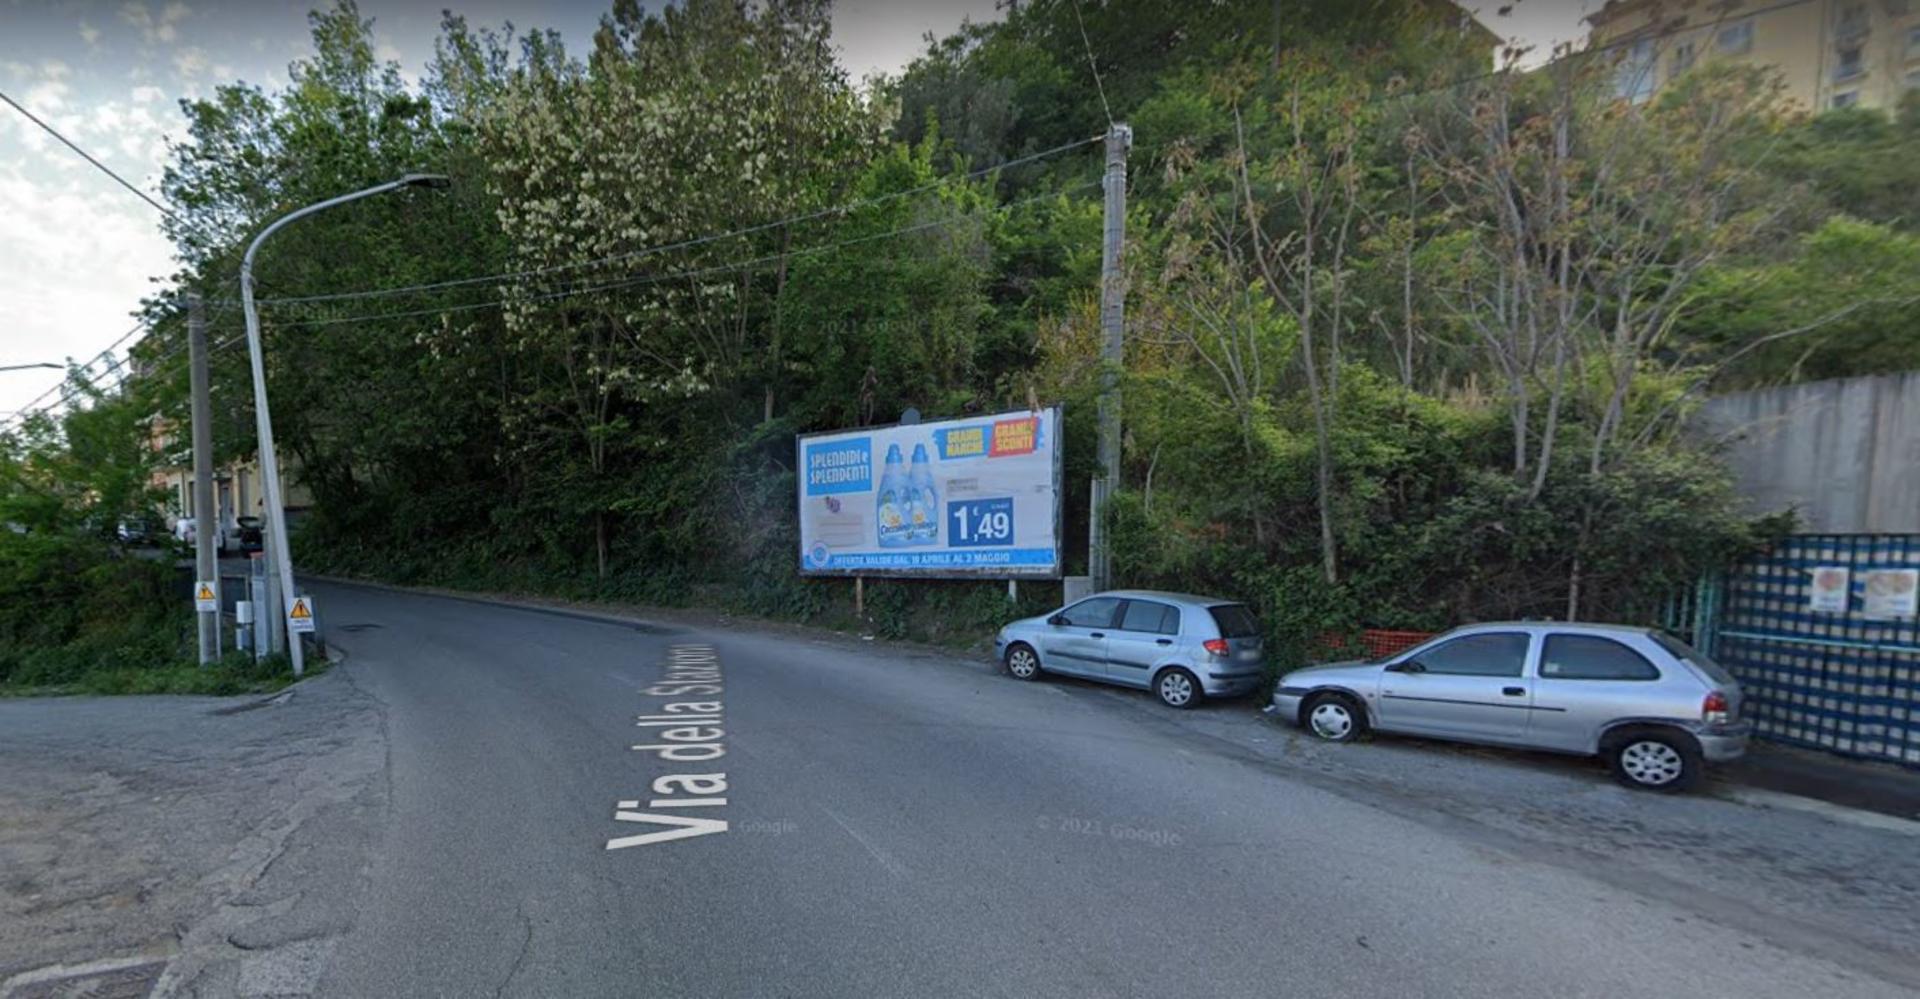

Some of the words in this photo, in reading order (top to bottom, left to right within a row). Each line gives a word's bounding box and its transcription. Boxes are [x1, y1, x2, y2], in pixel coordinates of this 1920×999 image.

[994, 434, 1033, 452] SCONTI
[810, 449, 861, 469] SPLENDIDI
[810, 464, 869, 485] SPLENDENTI
[921, 554, 950, 564] APRILE
[974, 551, 1010, 562] MAGGIO
